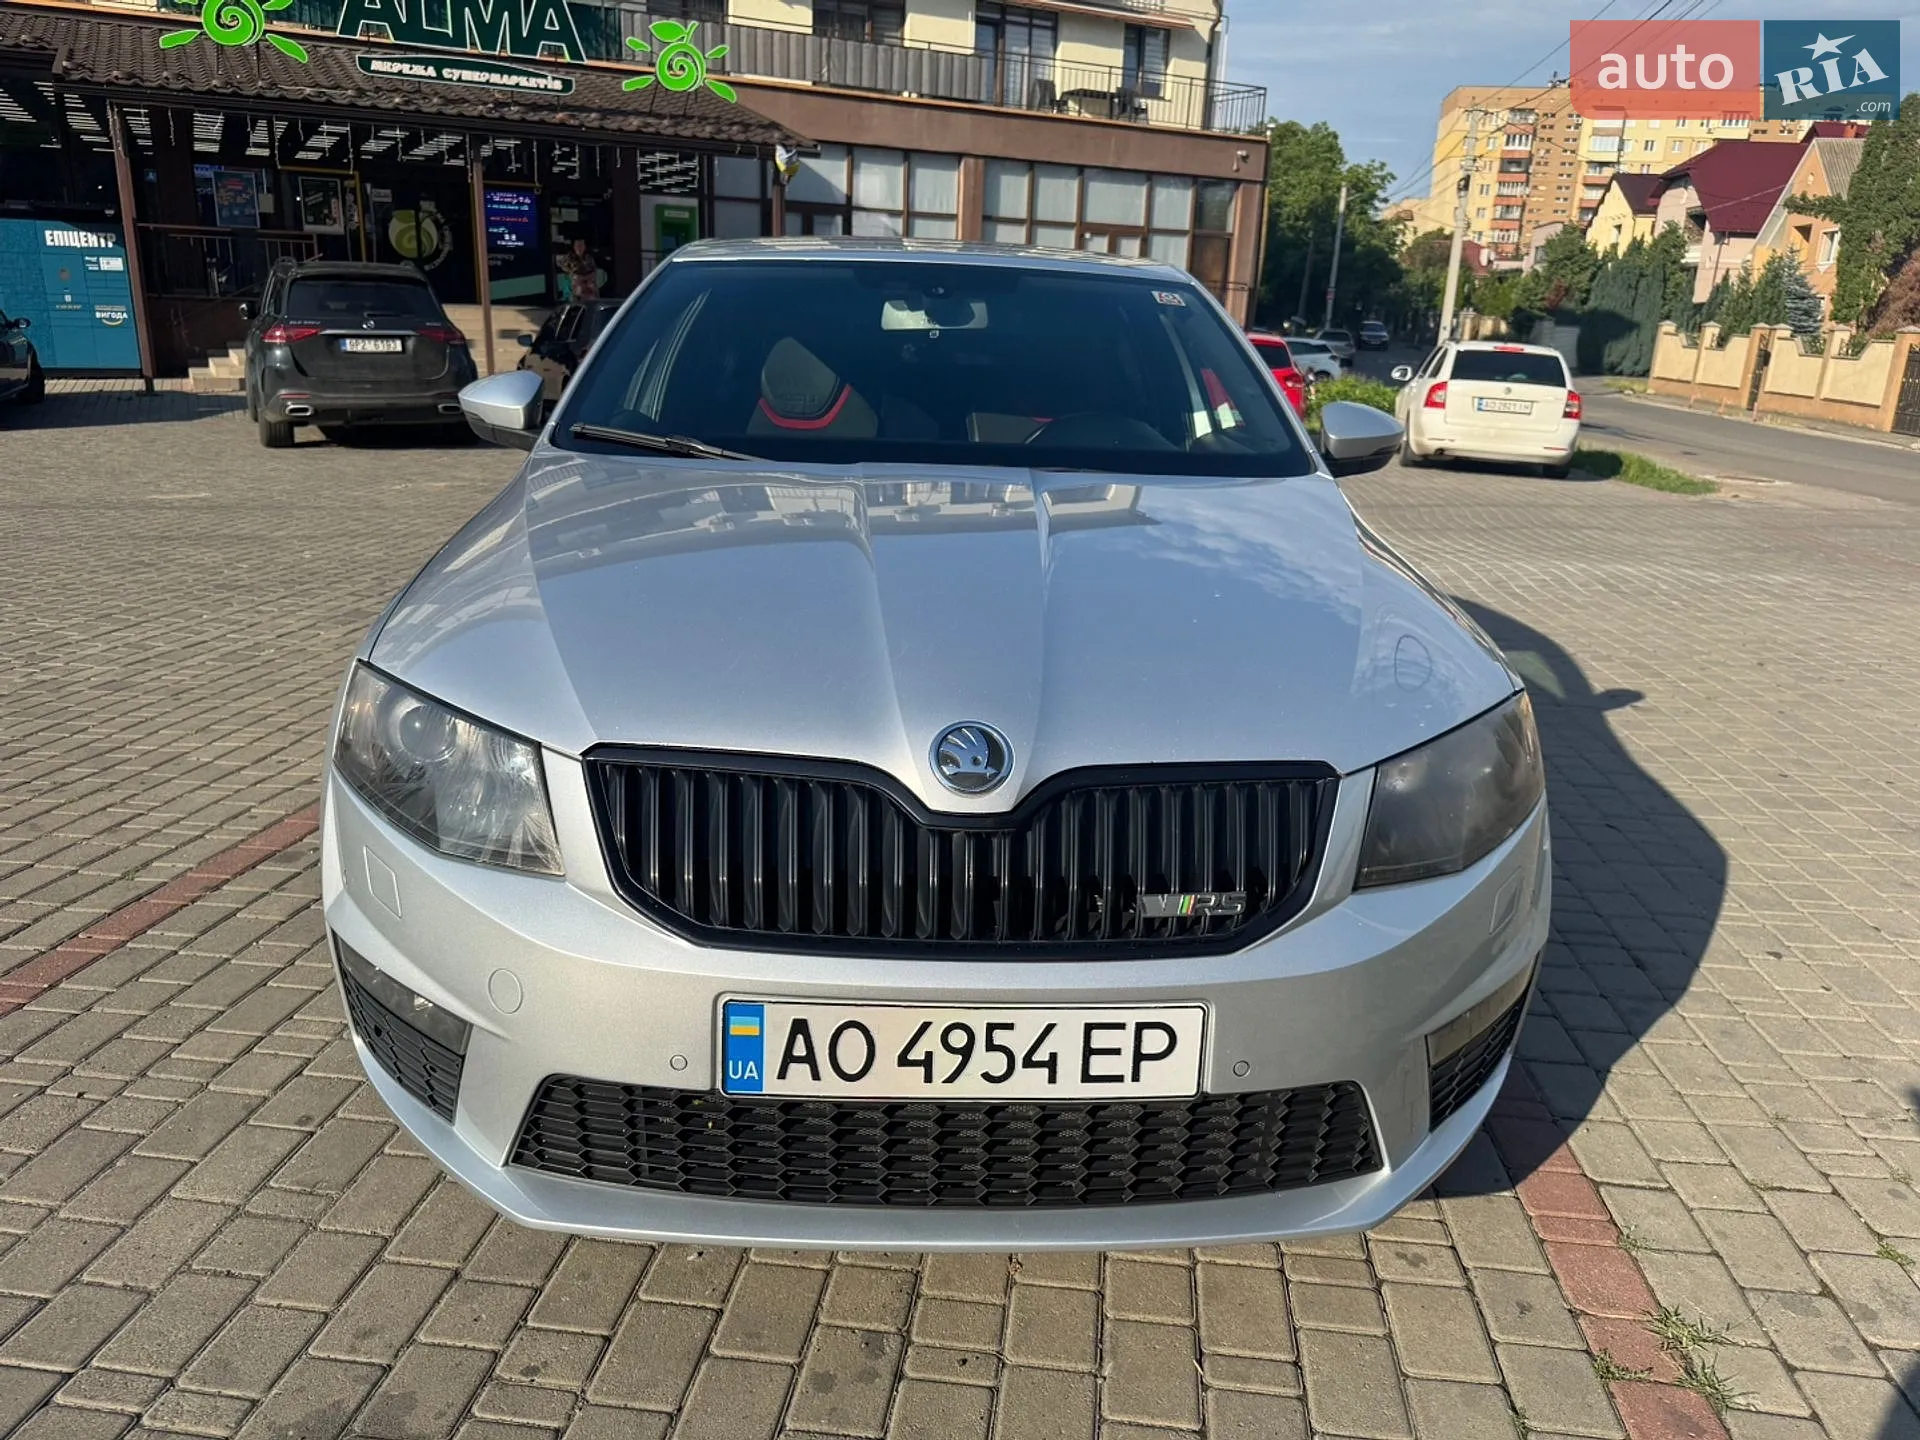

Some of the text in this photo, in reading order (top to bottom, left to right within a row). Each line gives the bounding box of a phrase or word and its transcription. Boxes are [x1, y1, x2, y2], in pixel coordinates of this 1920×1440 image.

[336, 0, 587, 63] ALMA
[44, 230, 116, 248] ЕПІЦЕНТР
[728, 1060, 760, 1080] UA
[776, 1018, 1177, 1084] AO 4954 EP
